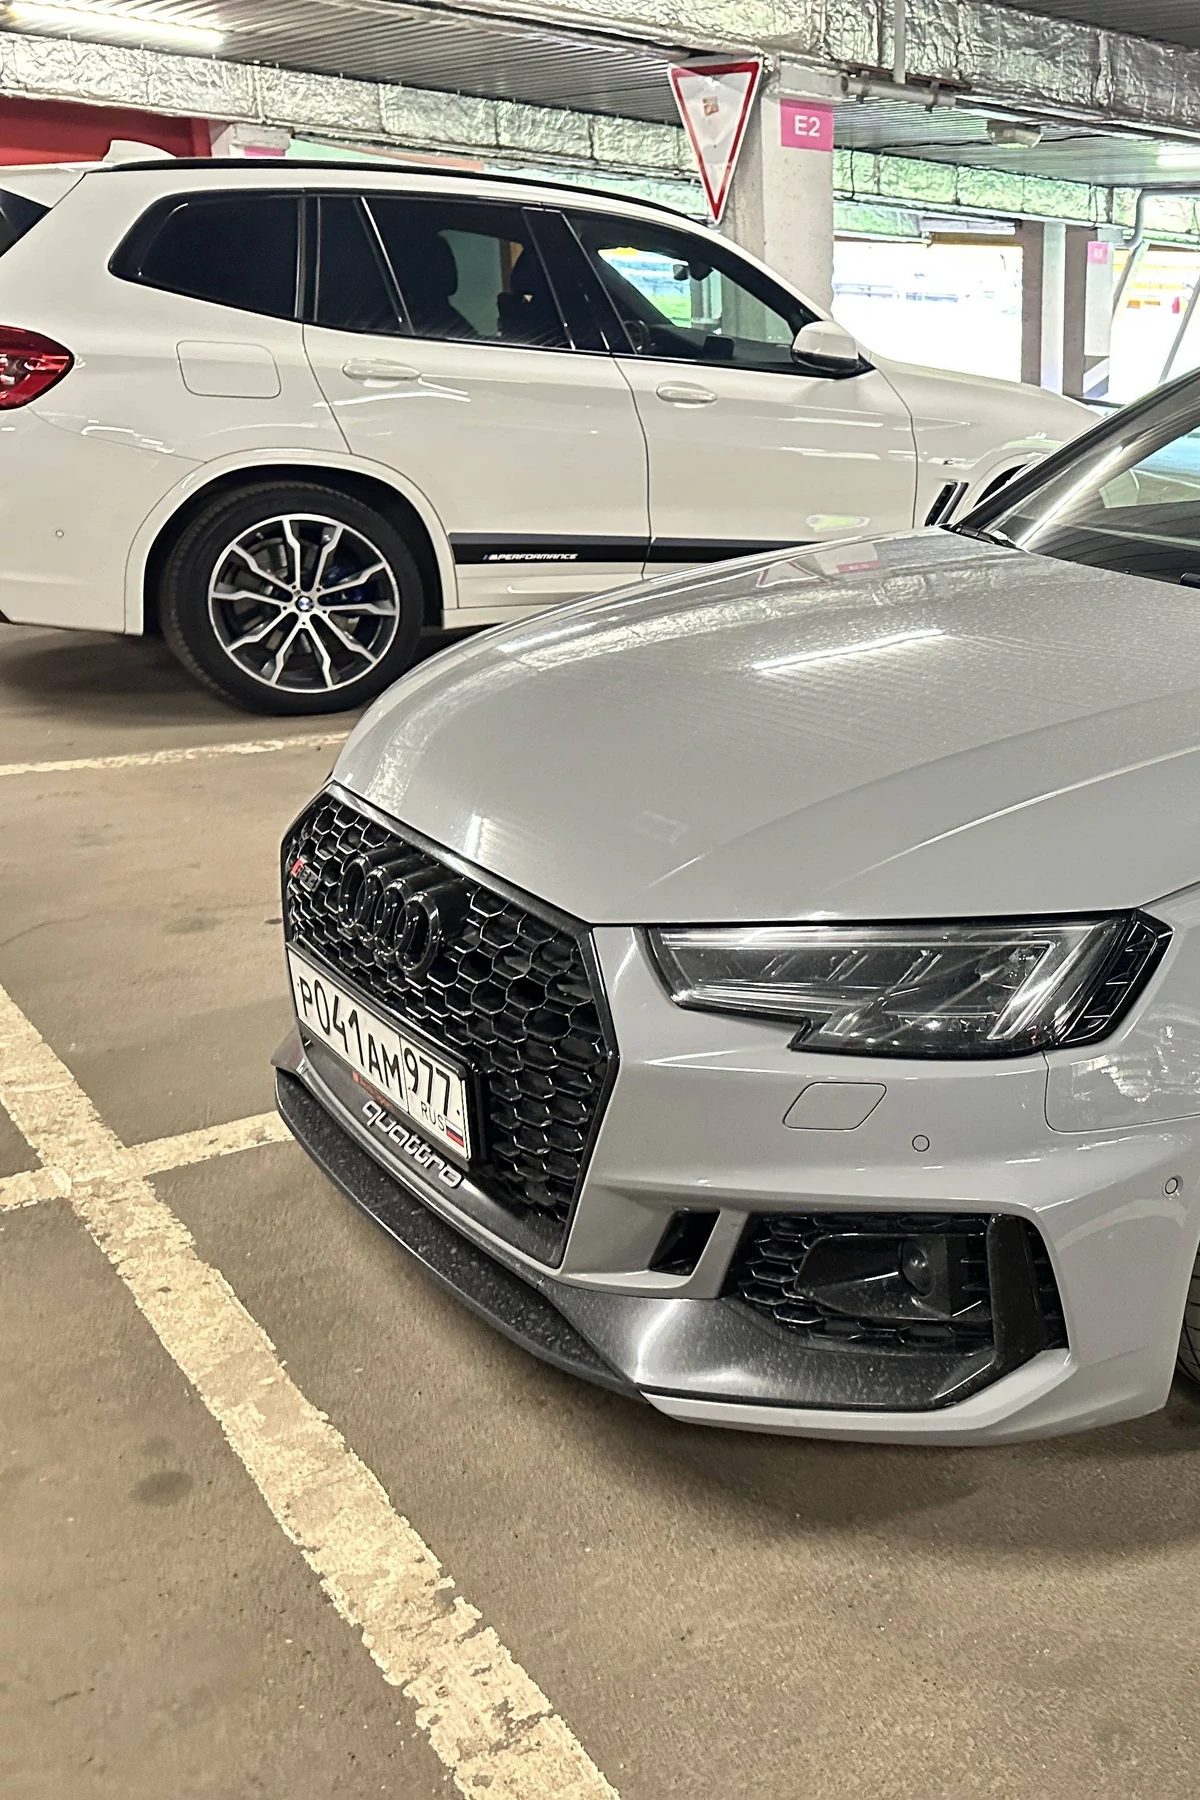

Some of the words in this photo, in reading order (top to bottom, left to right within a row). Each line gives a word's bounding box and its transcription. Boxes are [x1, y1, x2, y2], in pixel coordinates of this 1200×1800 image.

[795, 115, 821, 137] E2
[403, 1046, 451, 1117] 977
[420, 1101, 446, 1132] RUS
[362, 1099, 463, 1188] quattro
